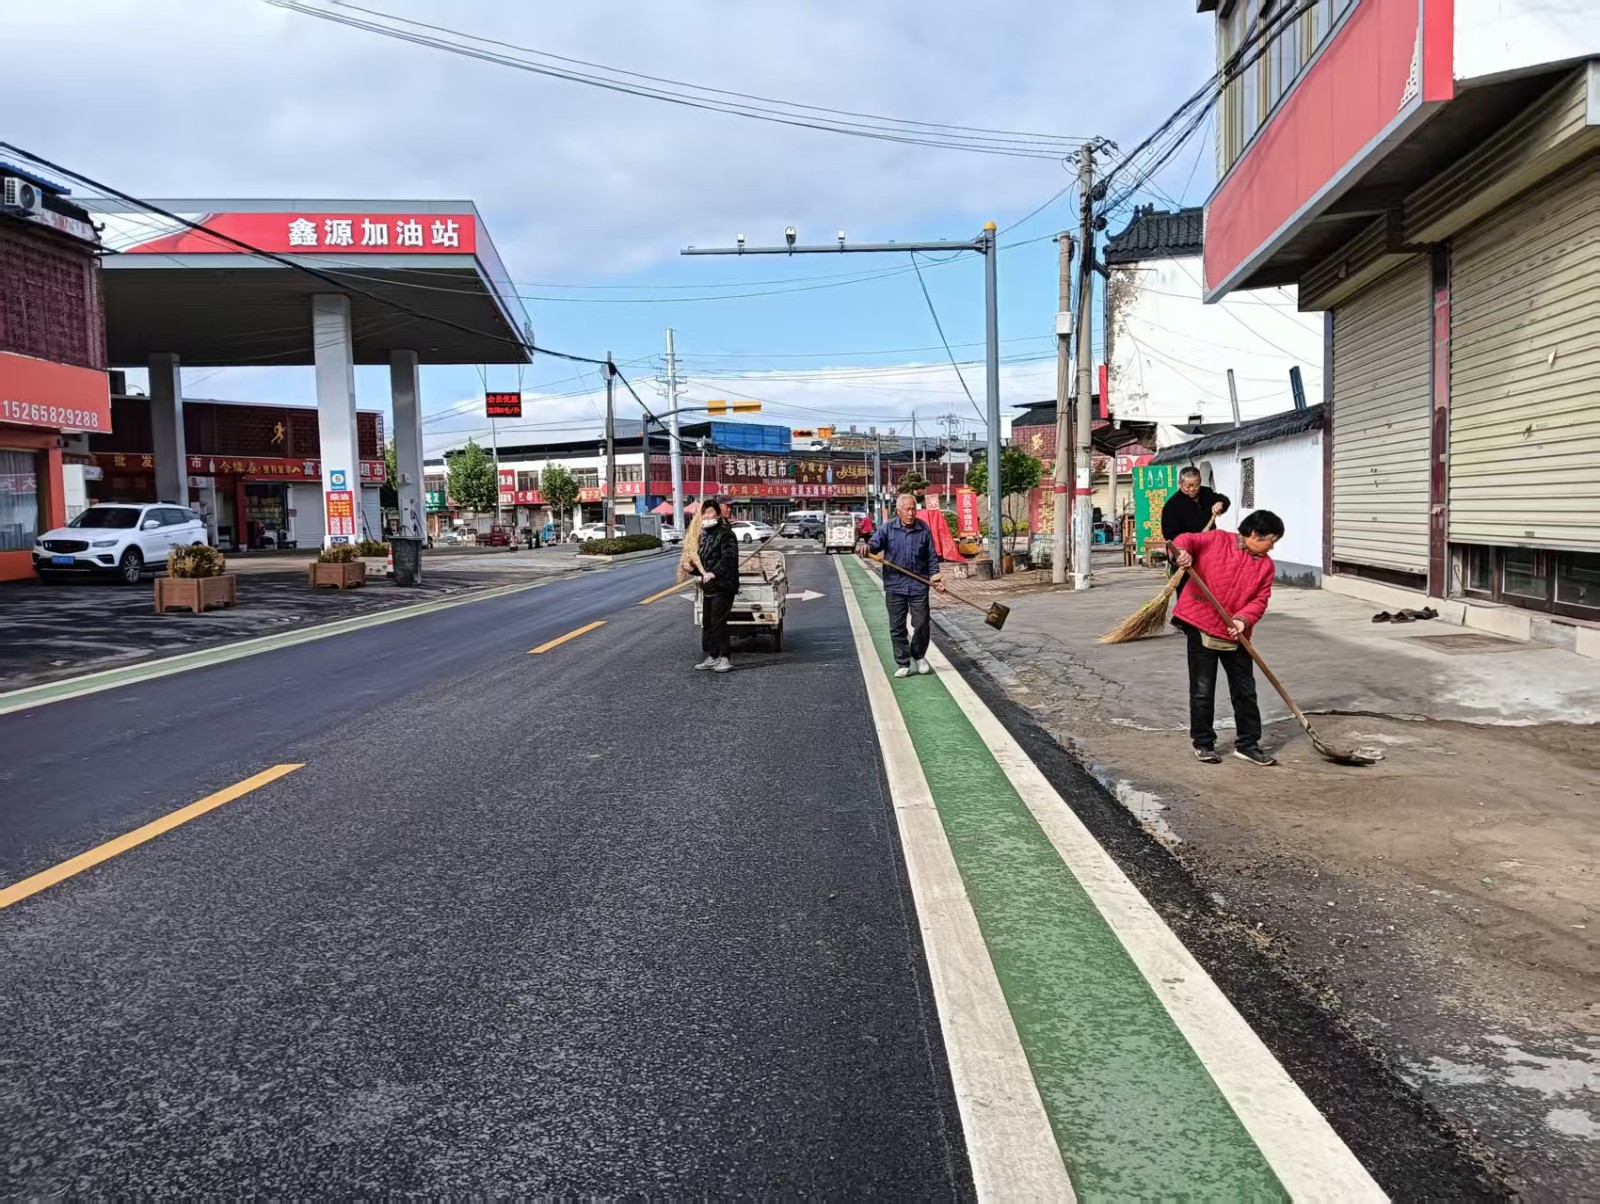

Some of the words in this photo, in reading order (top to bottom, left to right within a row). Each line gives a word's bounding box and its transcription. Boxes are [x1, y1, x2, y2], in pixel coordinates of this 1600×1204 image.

[288, 217, 459, 247] 鑫源加油站
[3, 400, 98, 428] 15265829288
[724, 459, 788, 477] 志强批发超市
